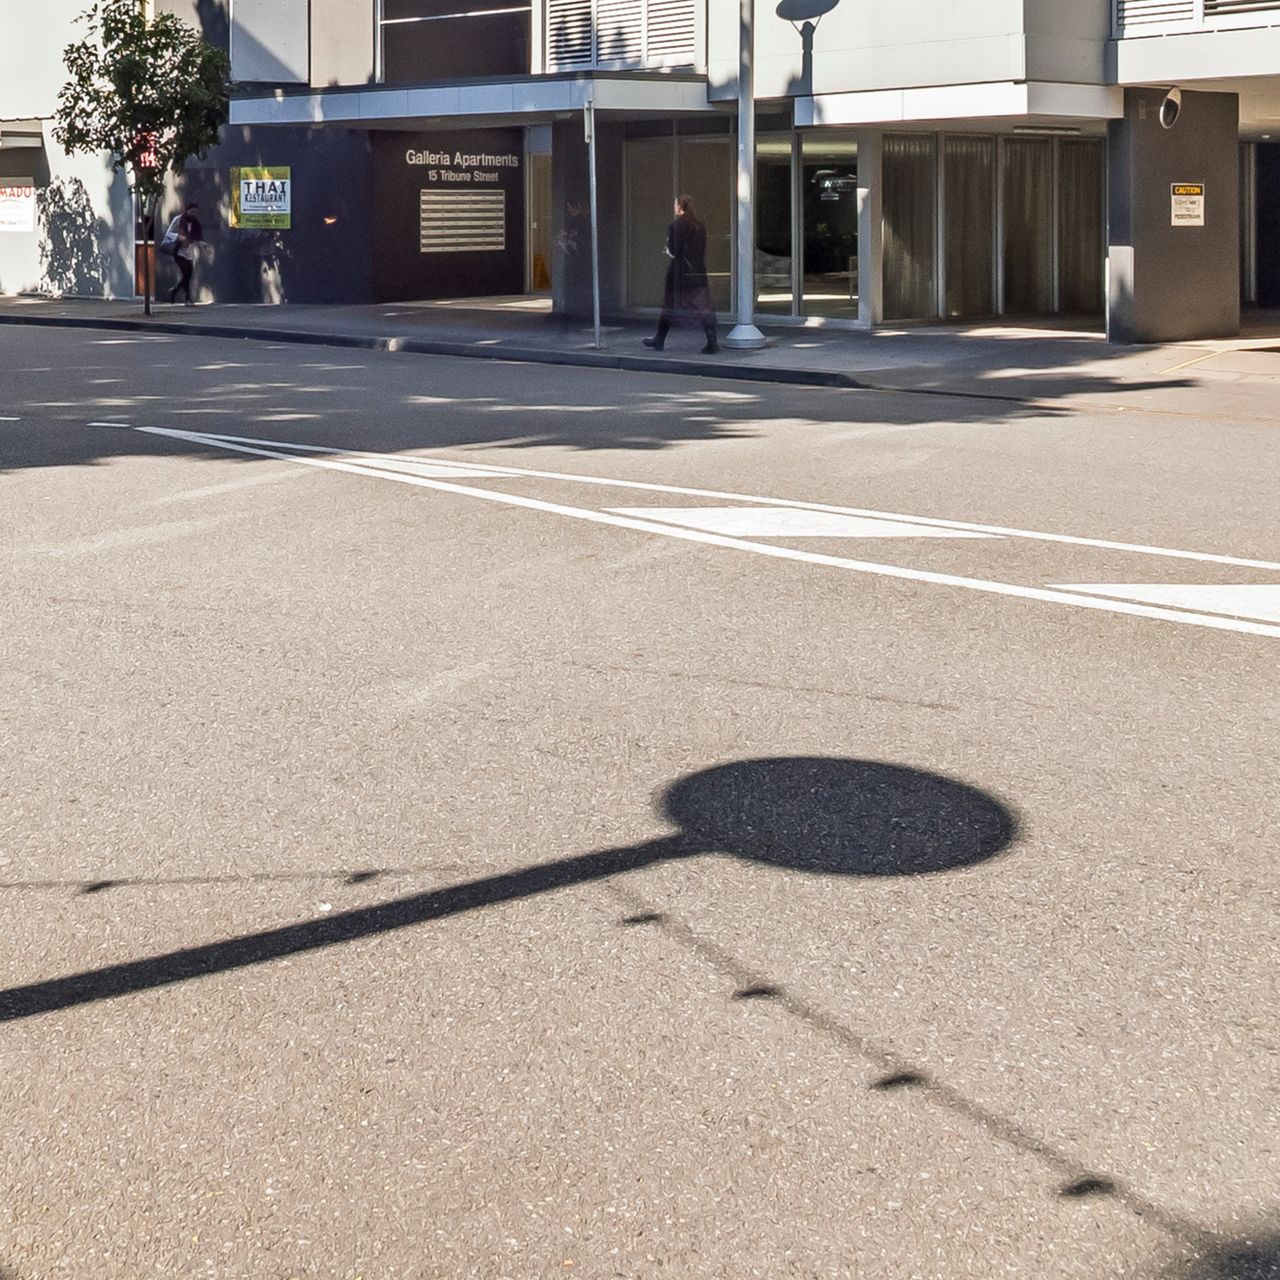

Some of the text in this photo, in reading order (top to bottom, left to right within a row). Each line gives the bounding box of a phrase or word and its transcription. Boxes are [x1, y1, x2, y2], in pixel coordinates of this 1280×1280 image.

[406, 149, 519, 169] Galleria Apartments
[428, 170, 499, 181] 15 Tribune Street
[0, 185, 32, 198] MADO
[244, 181, 287, 194] THAI
[1174, 186, 1201, 194] CAUTION
[245, 193, 287, 203] RESTAURANT
